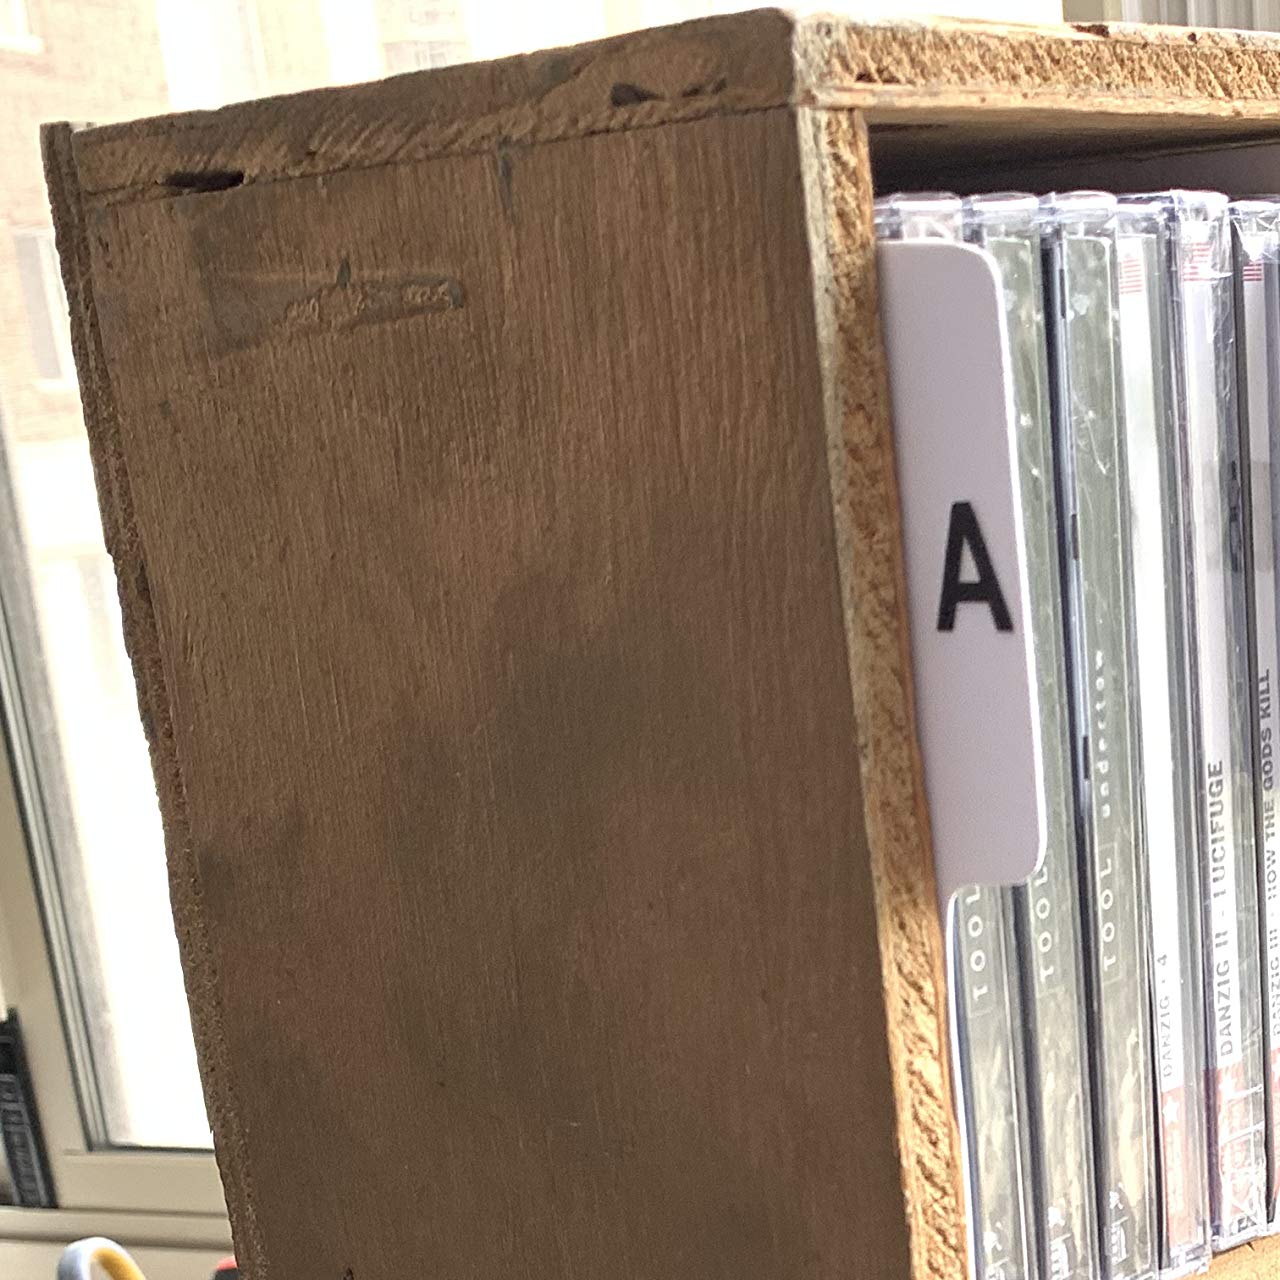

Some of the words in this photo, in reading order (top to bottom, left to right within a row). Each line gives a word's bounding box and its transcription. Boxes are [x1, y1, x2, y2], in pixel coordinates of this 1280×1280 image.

[936, 501, 1015, 633] A
[1257, 669, 1271, 719] KILL
[1093, 649, 1112, 818] undertow
[1259, 727, 1273, 790] GODS
[1206, 761, 1228, 897] LUCIFUGE
[1262, 800, 1275, 841] THE
[1263, 851, 1277, 899] HOW
[1032, 863, 1056, 986] TOOL
[1098, 856, 1119, 973] TOOL
[1213, 930, 1229, 947] II
[1267, 929, 1280, 948] III
[1155, 953, 1169, 967] 4
[1159, 996, 1174, 1078] DANZIG
[1216, 960, 1234, 1056] DANZIG
